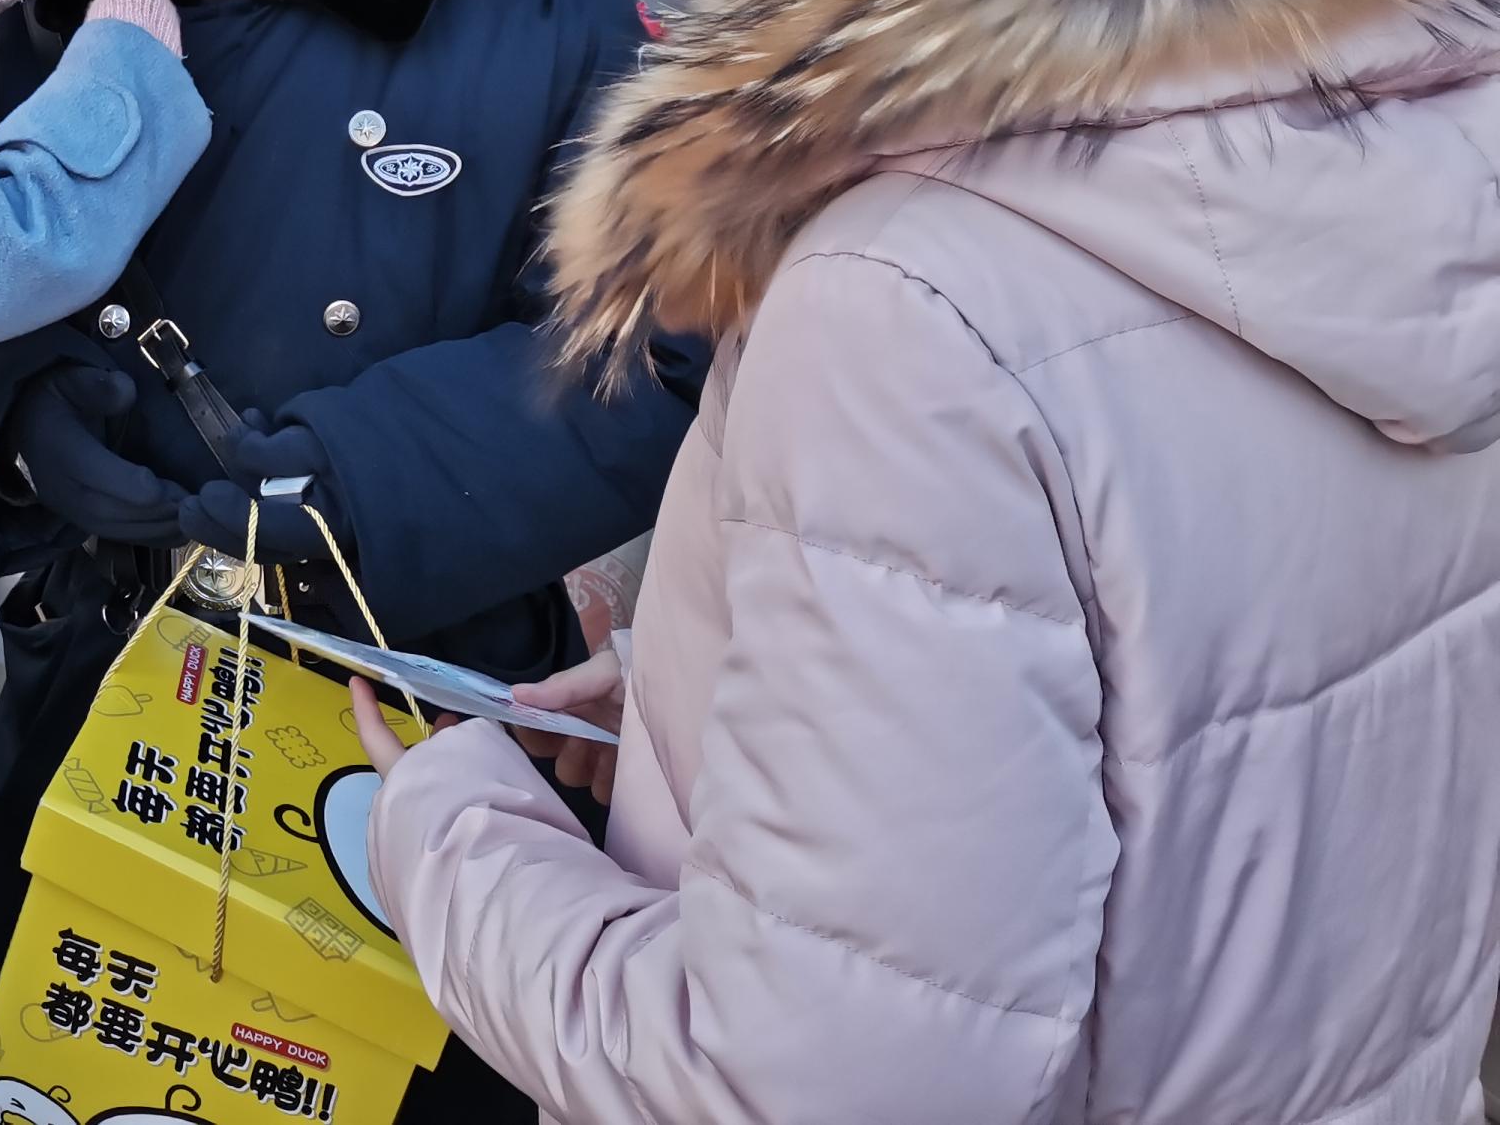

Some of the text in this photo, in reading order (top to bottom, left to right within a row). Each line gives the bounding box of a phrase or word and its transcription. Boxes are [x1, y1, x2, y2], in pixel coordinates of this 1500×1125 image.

[181, 645, 202, 703] HAPPY DUCK
[111, 739, 180, 824] 每天
[52, 927, 159, 1003] 每天
[234, 1026, 328, 1067] HAPPY DUCK
